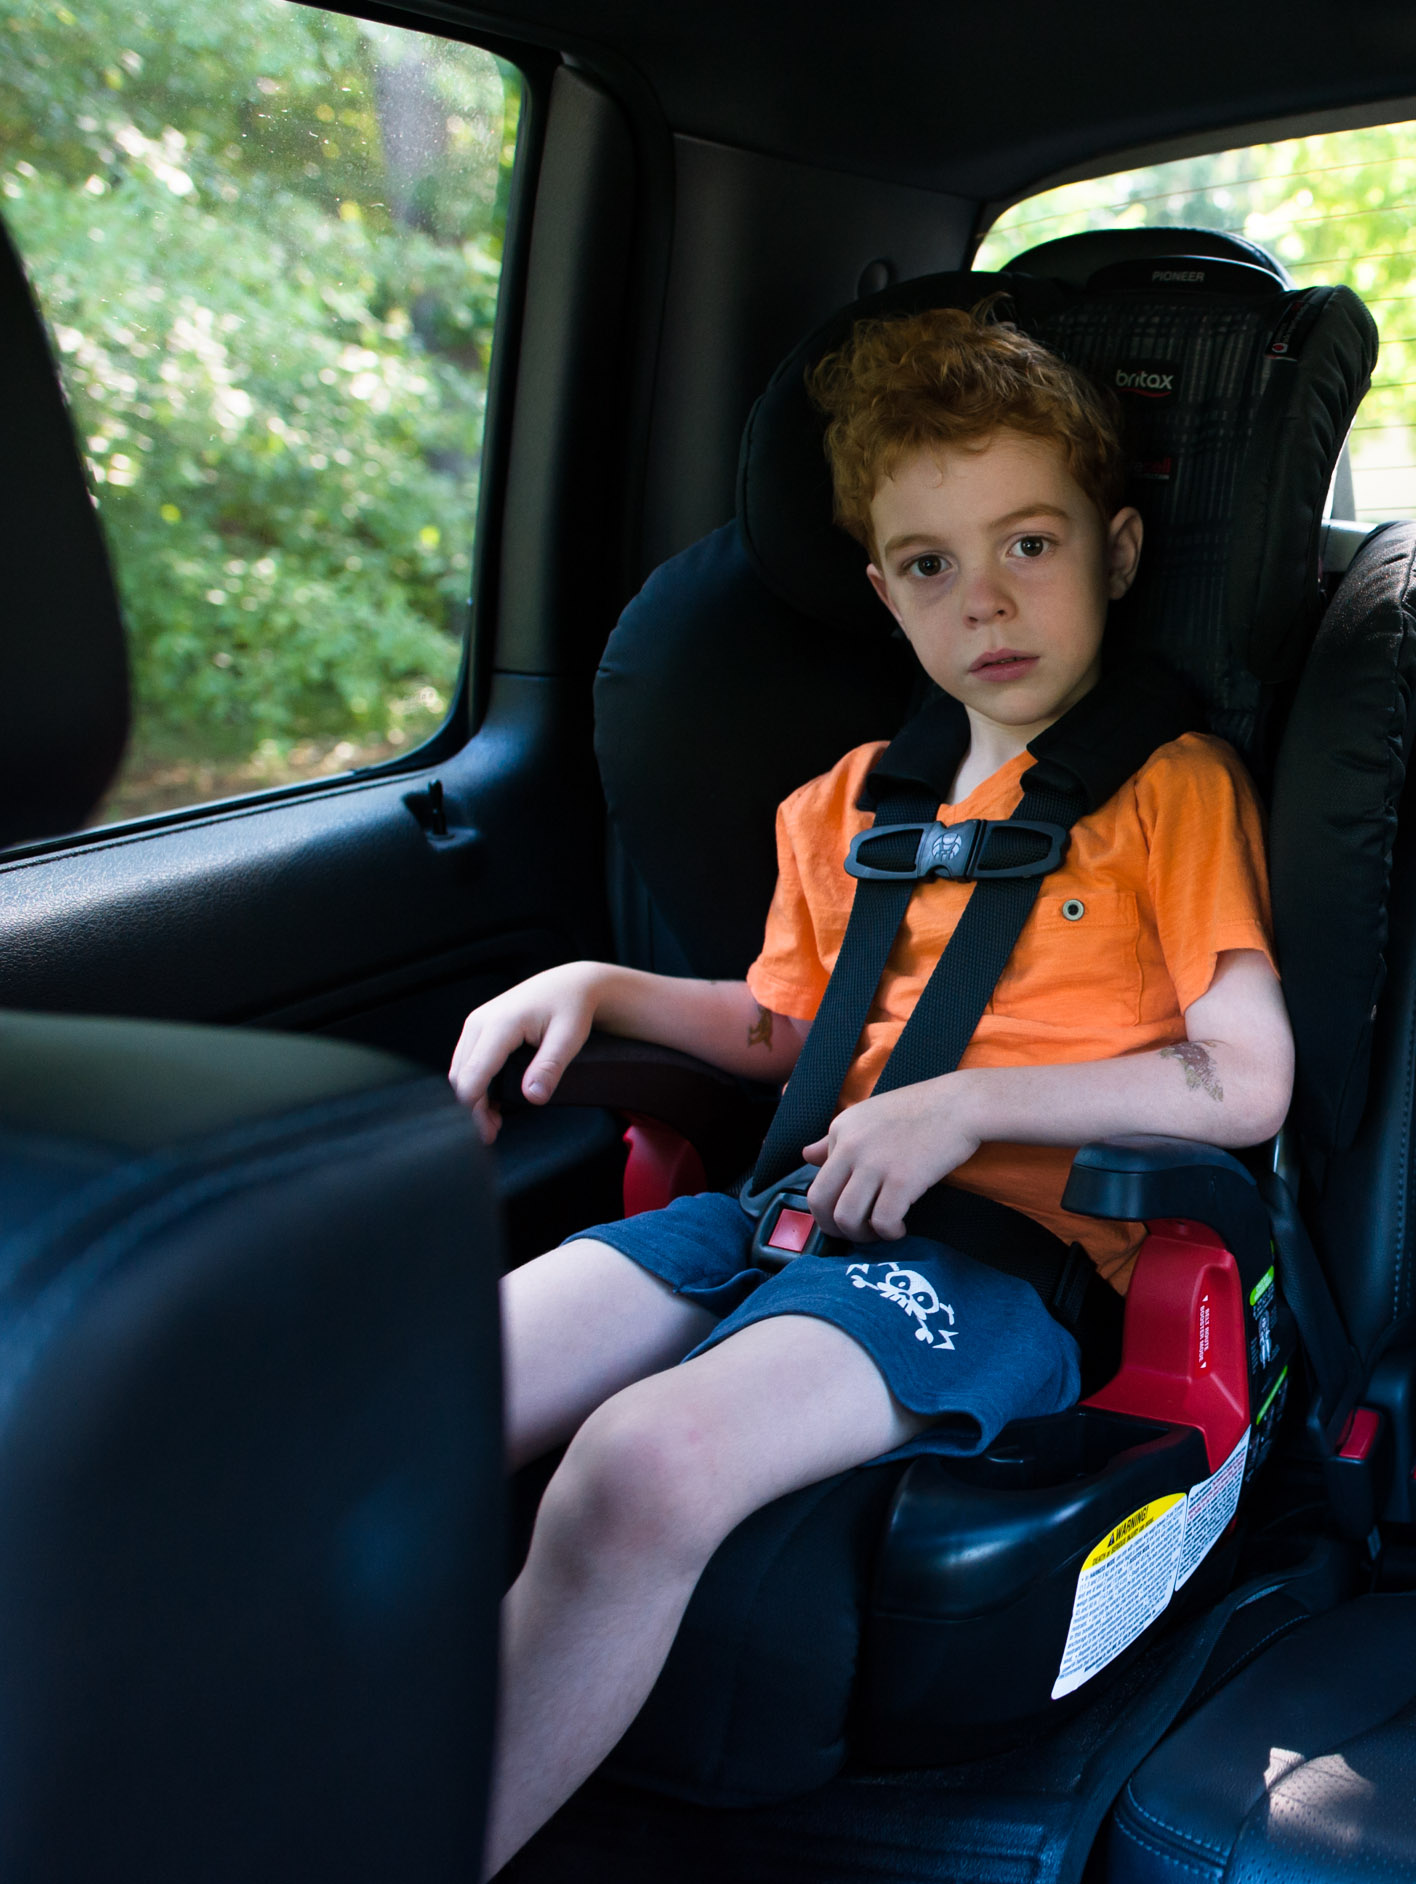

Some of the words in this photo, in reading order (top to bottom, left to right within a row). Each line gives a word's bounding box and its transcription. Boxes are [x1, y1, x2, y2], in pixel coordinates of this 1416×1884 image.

[1151, 271, 1206, 282] PIONEER
[1115, 369, 1175, 390] britax
[1115, 1504, 1149, 1542] WARNING!
